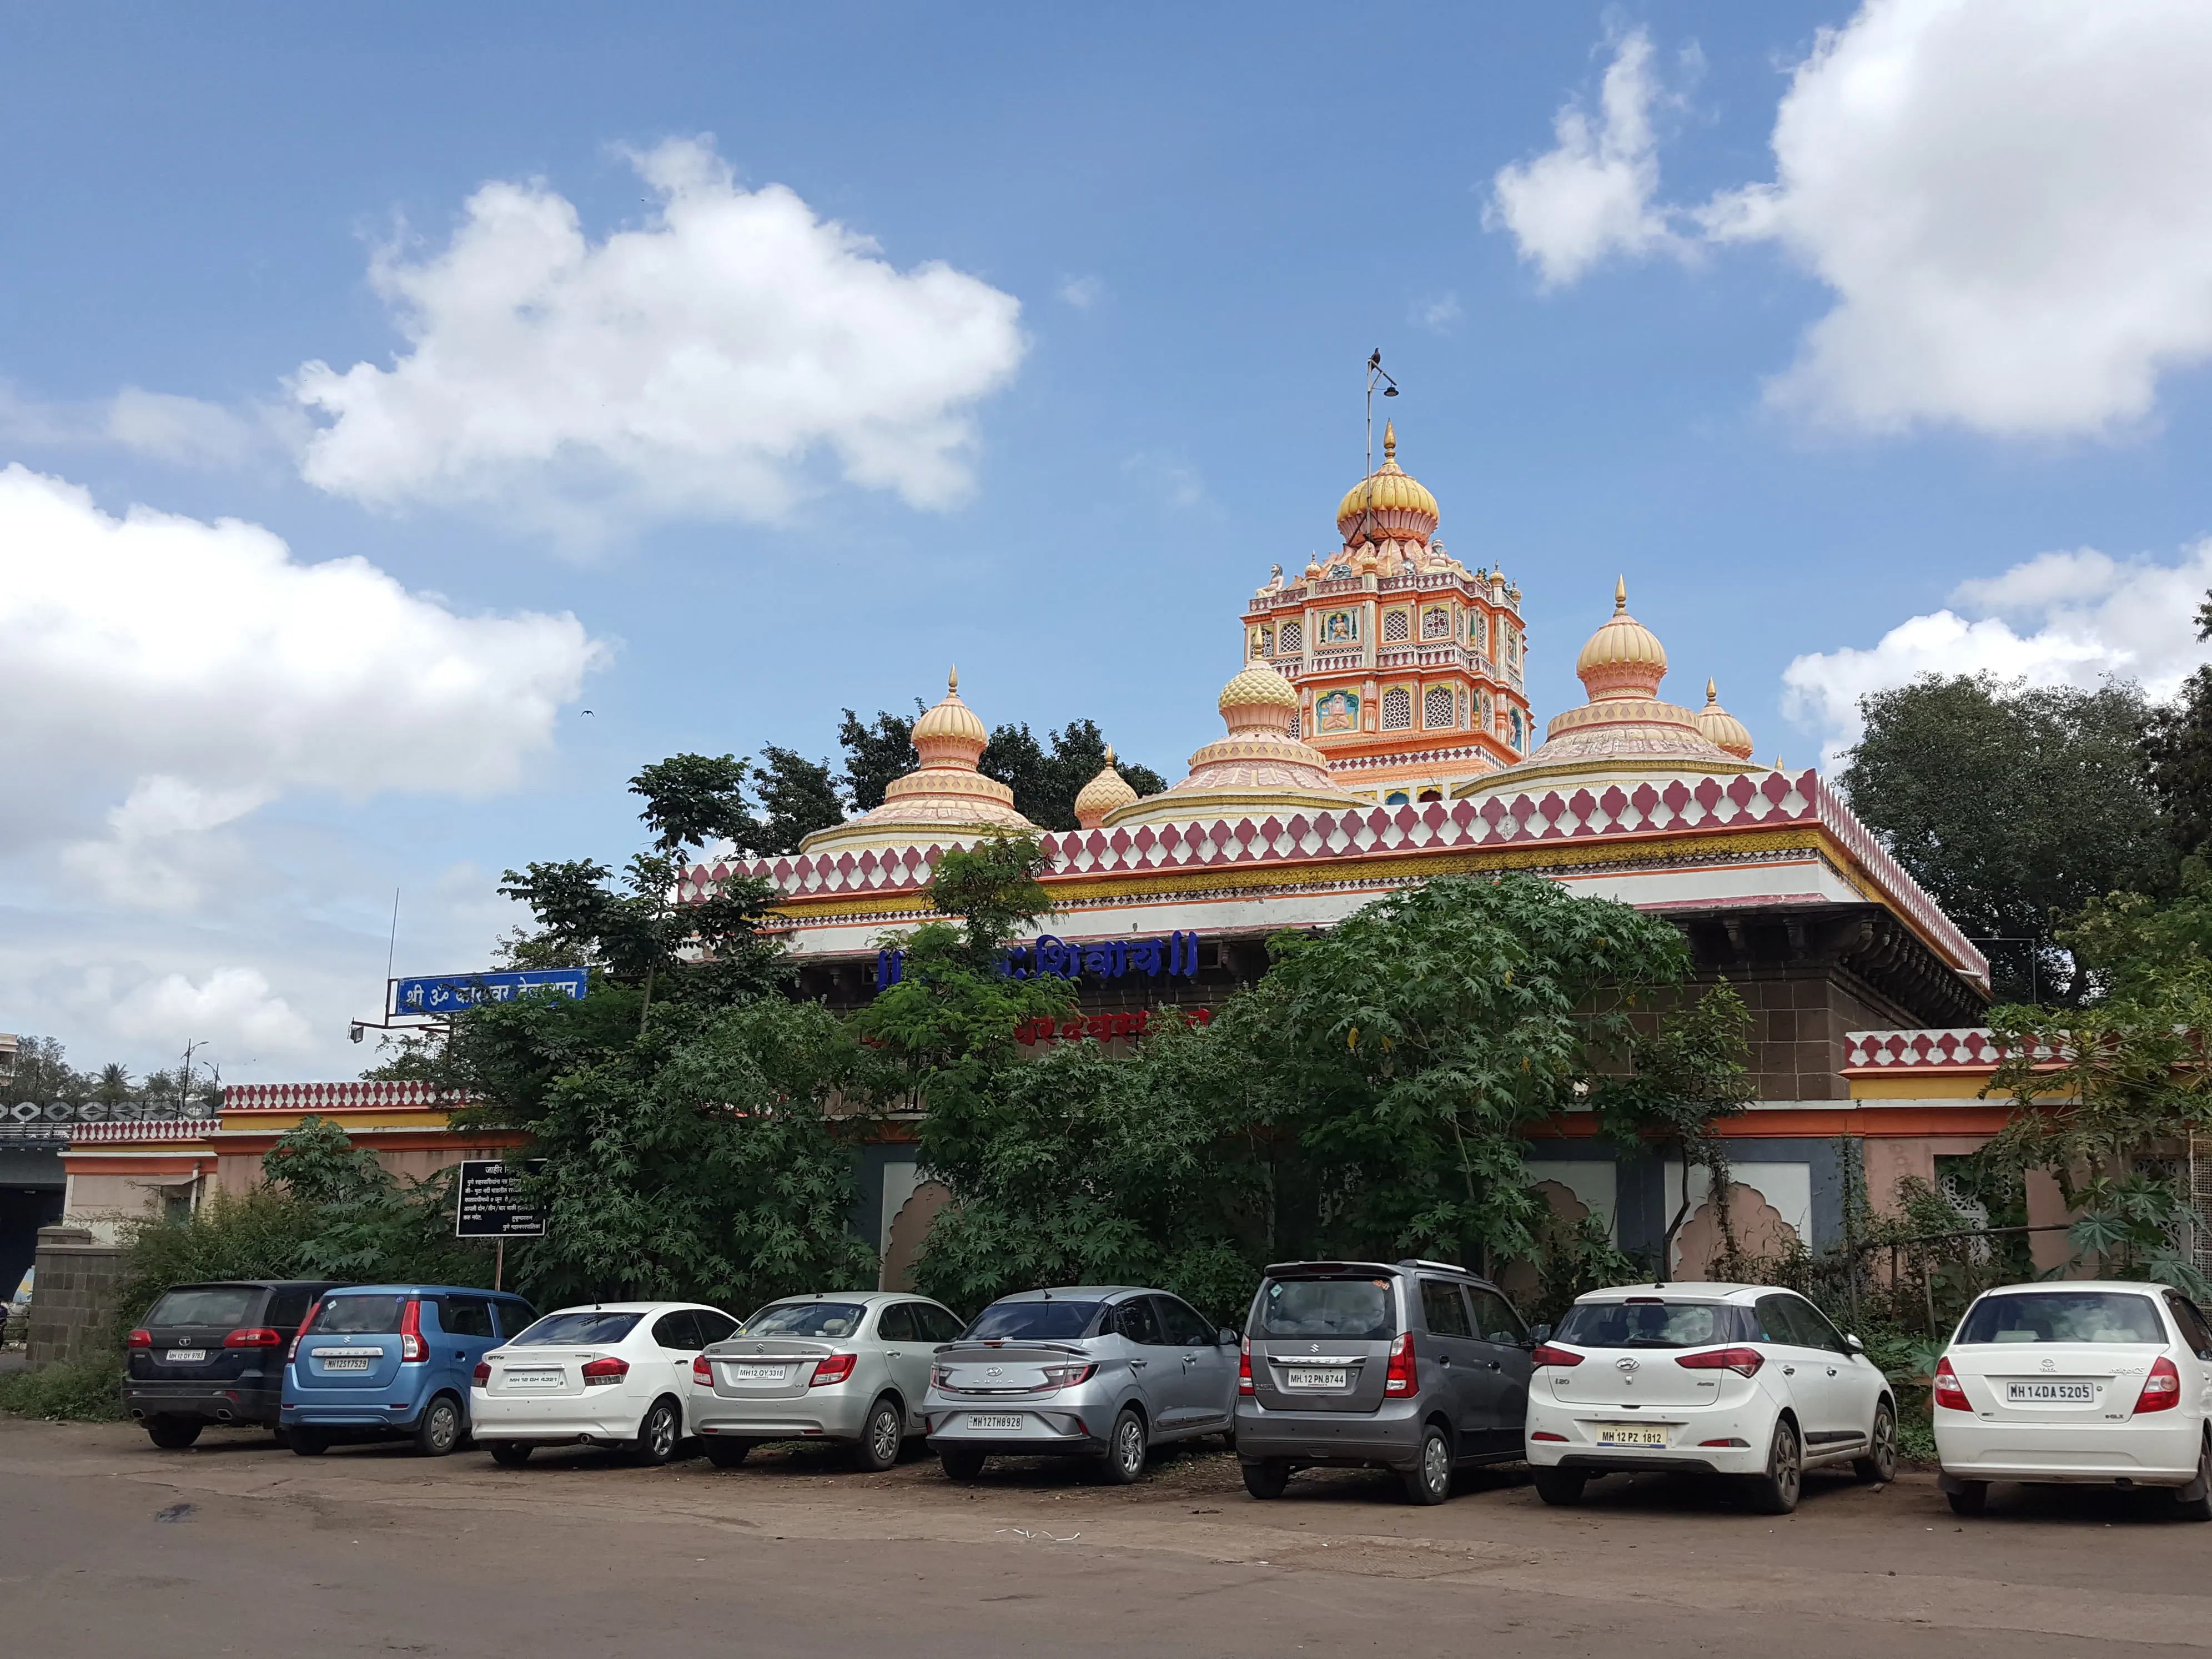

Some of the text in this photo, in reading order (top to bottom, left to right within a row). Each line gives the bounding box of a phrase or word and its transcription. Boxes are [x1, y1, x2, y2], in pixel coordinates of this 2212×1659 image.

[406, 984, 424, 1006] श्री
[485, 1164, 502, 1174] जाहीर
[328, 1360, 367, 1368] MH12SY7529
[973, 1416, 1021, 1427] MH12TH8928
[1602, 1431, 1662, 1443] MH 12 PZ 1812
